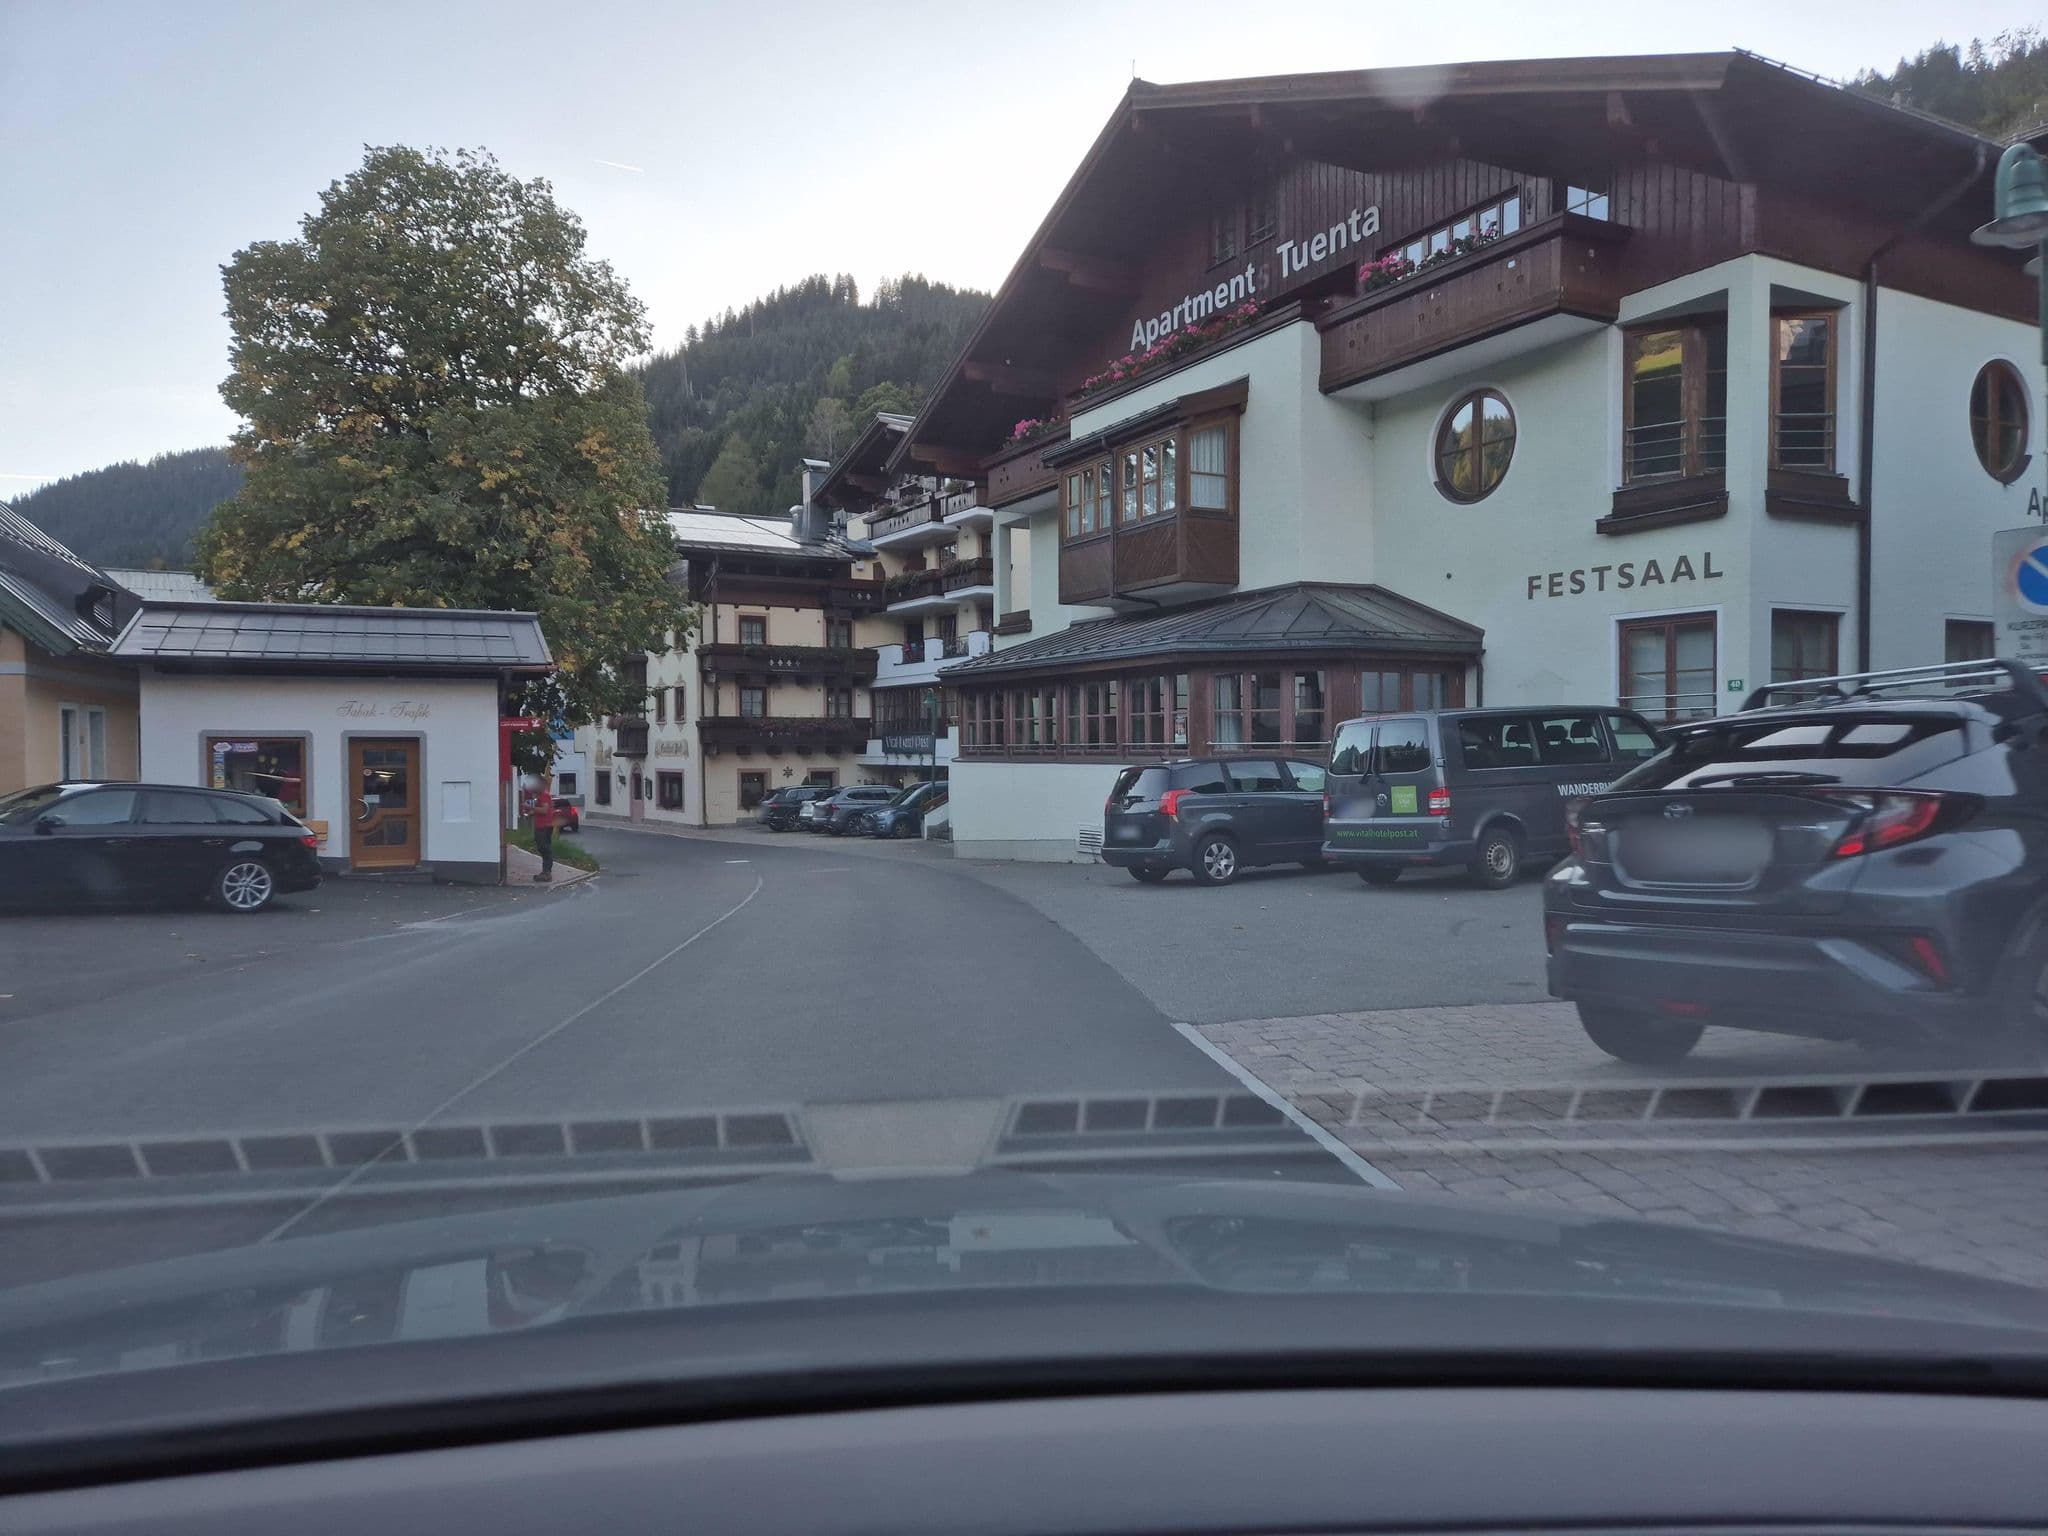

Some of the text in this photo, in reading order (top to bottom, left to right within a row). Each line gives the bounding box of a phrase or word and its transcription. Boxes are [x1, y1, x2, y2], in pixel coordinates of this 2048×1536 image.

[1276, 205, 1381, 279] Tuenta
[1527, 551, 1724, 600] FESTSAAL
[336, 700, 377, 718] Tabak
[389, 701, 433, 723] Trafik
